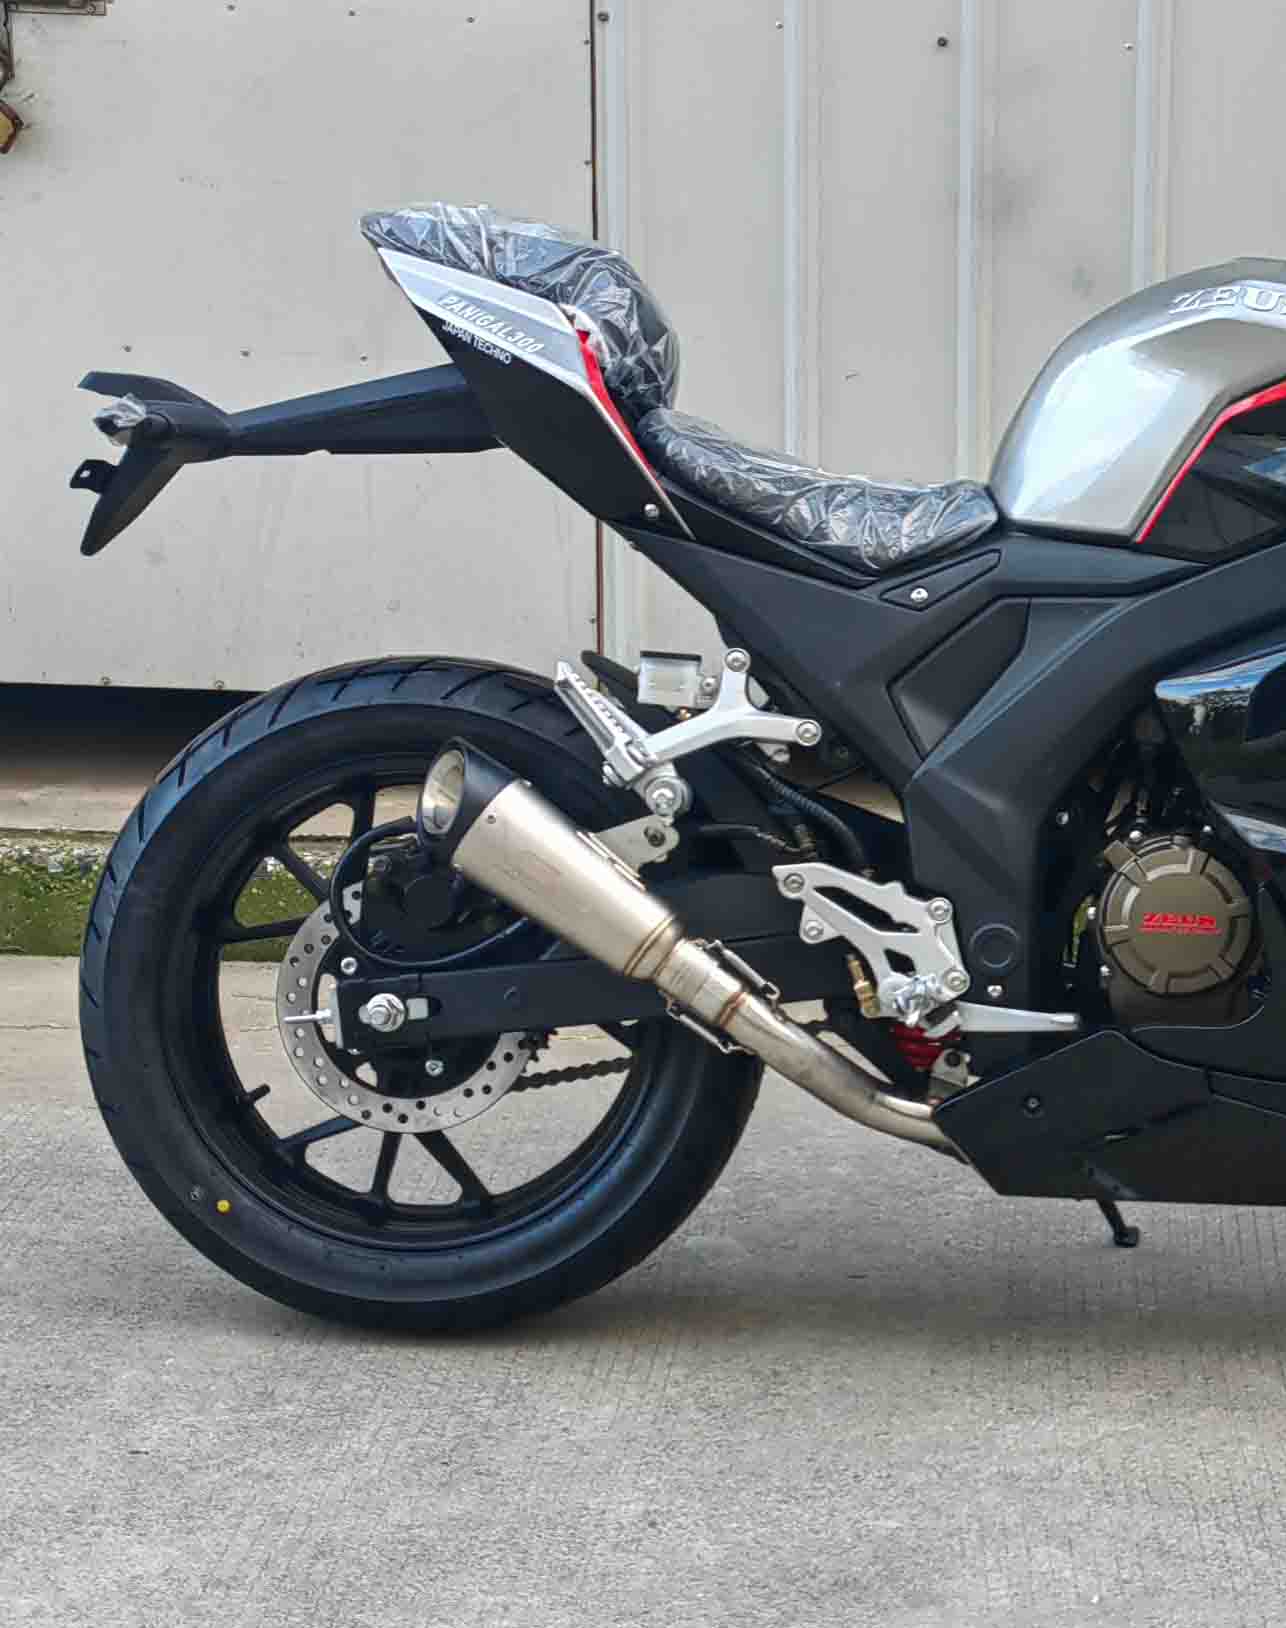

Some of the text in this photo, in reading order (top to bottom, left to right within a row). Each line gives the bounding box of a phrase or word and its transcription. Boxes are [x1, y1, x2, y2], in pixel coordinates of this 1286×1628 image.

[441, 320, 512, 365] JAPAN TECHNO
[1142, 912, 1217, 929] ZEUS
